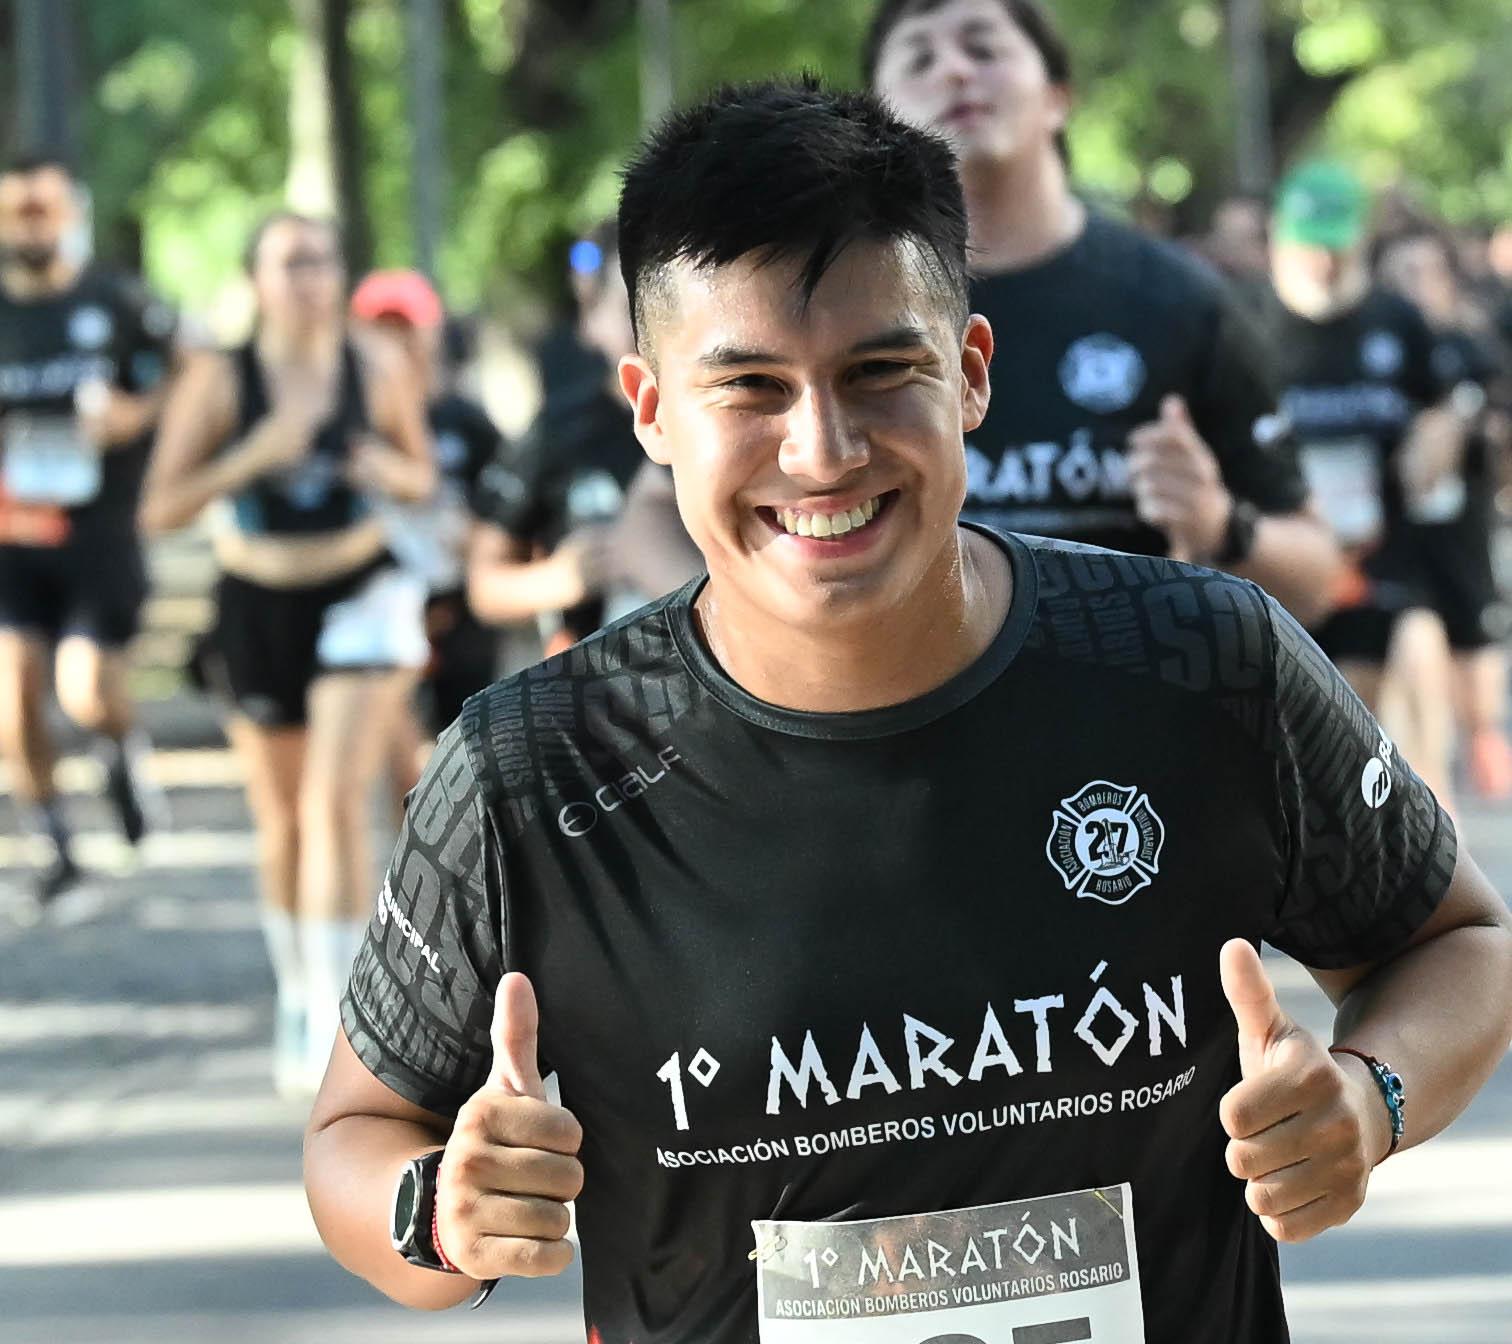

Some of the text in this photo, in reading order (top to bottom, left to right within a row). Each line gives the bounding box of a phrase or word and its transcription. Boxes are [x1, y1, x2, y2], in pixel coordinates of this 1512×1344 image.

[1077, 791, 1124, 813] BOMBEROS
[1085, 818, 1129, 862] 27
[1095, 875, 1133, 894] ROSARIO
[765, 959, 1187, 1115] MARATÓN
[656, 1065, 1196, 1169] ASOCIACIÓN BOMBEROS VOLUNTARIOS ROSARIO
[858, 1210, 1081, 1286] MARATÓN
[774, 1262, 1124, 1318] ASOCIACIÓN BOMBEROS VOLUNTARIOS ROSARIO
